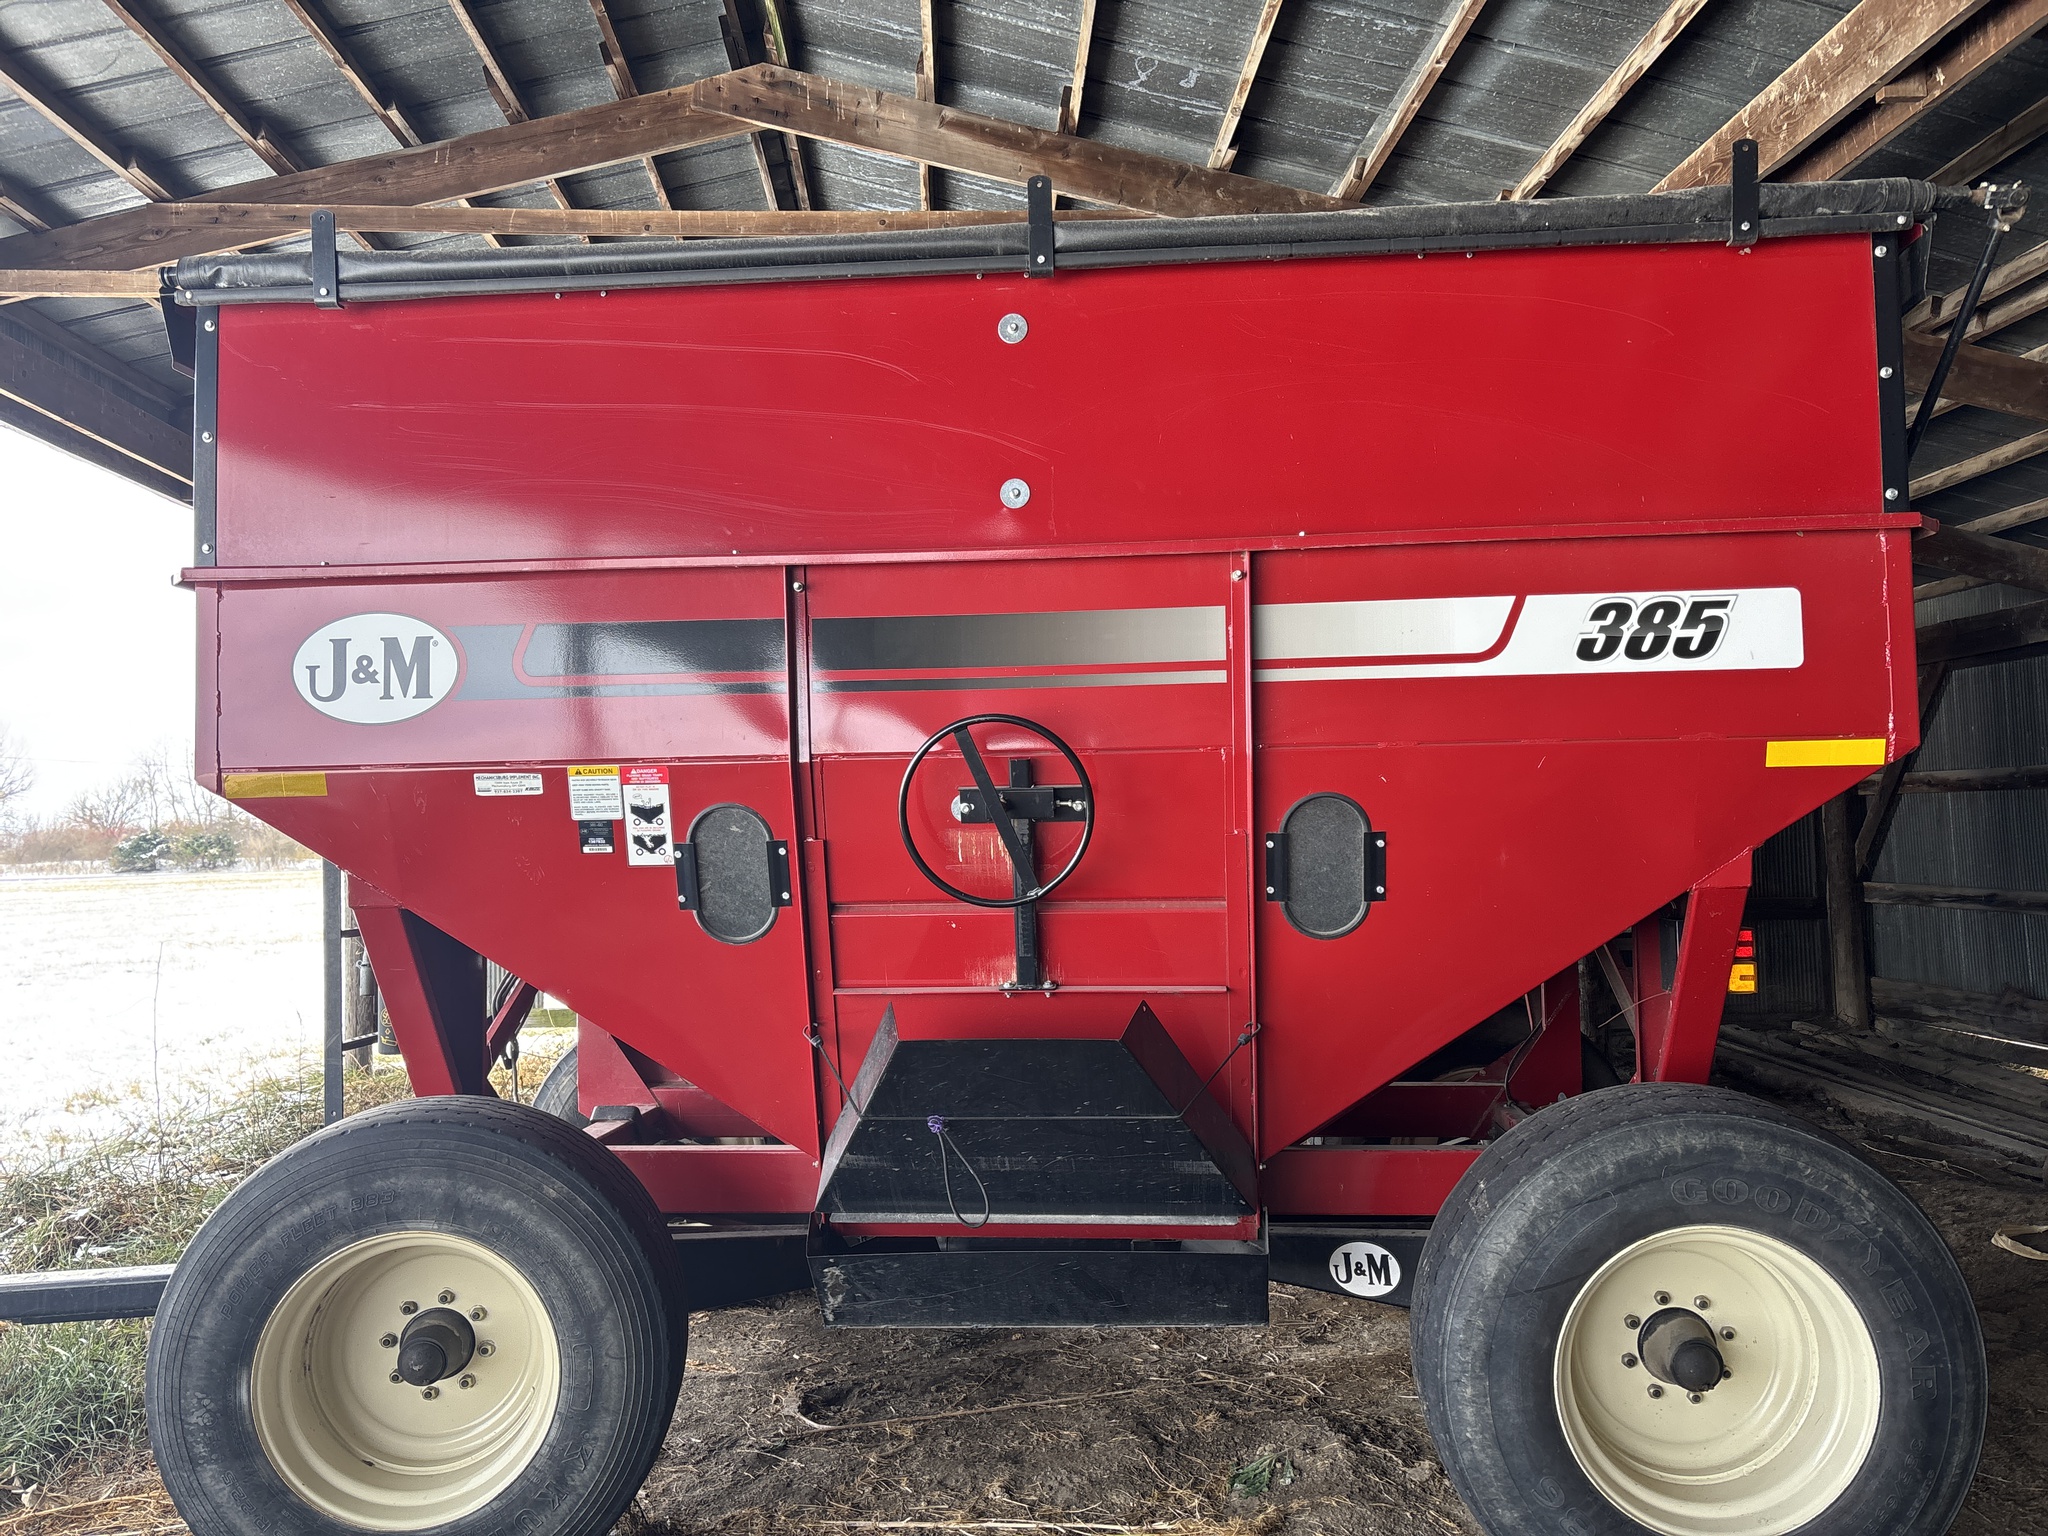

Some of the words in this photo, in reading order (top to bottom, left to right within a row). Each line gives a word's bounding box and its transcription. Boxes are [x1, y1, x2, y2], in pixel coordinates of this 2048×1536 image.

[1575, 598, 1736, 663] 385
[305, 635, 434, 703] J&M
[582, 767, 613, 775] CAUTION
[219, 1250, 274, 1320] POWER
[278, 1203, 340, 1250] FLEET
[349, 1189, 397, 1213] 983
[1332, 1251, 1394, 1287] J&M
[1670, 1177, 1939, 1401] GOODYEAR
